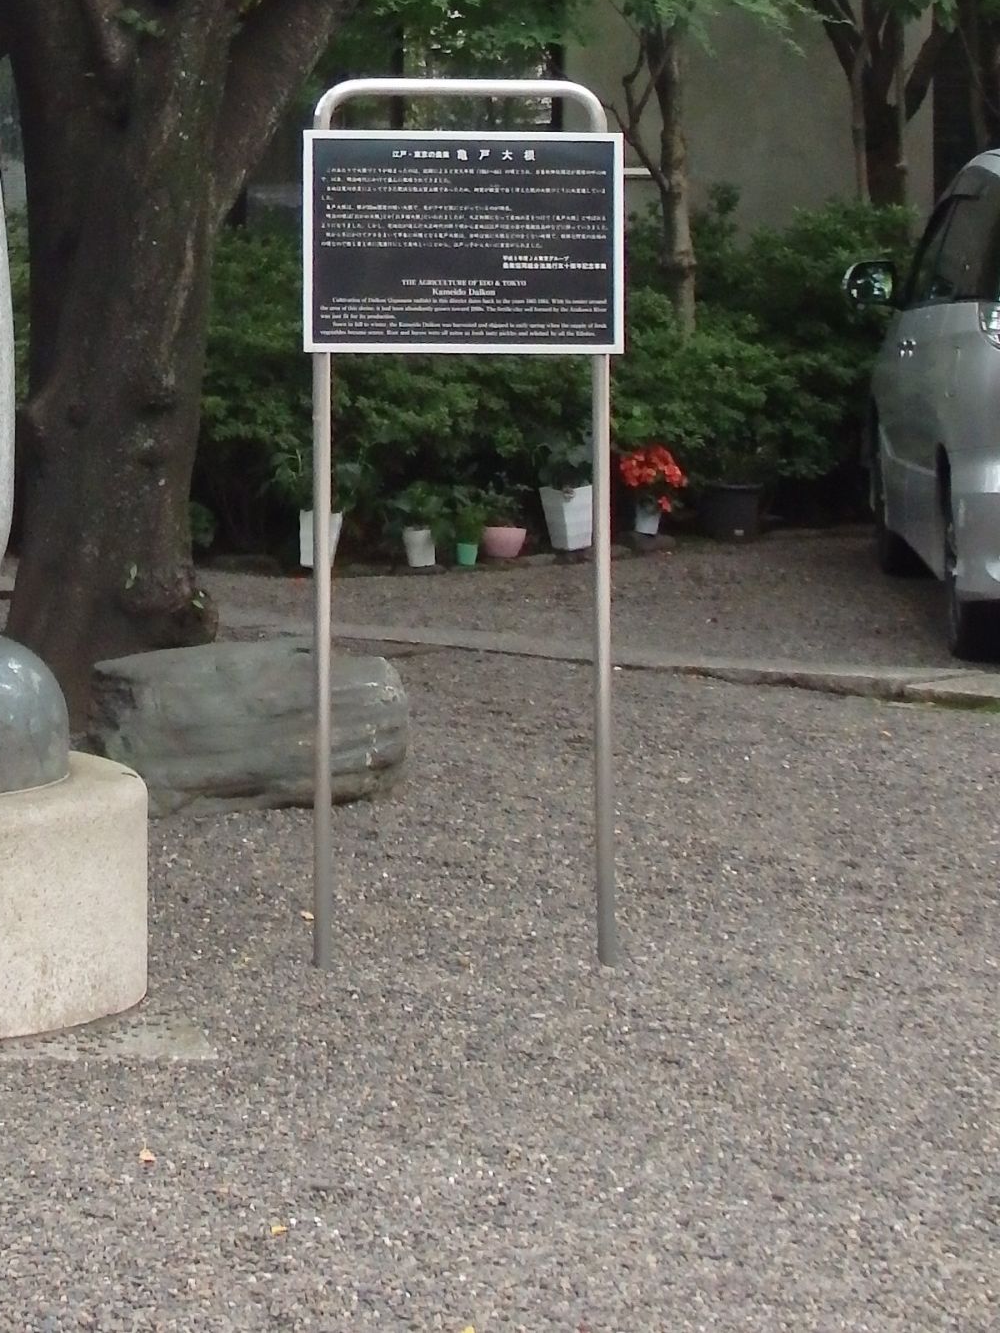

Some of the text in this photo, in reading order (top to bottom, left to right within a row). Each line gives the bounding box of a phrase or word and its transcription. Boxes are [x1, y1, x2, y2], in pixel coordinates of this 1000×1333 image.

[457, 149, 536, 161] 亀戸大根
[432, 288, 496, 296] Kameido Daikon
